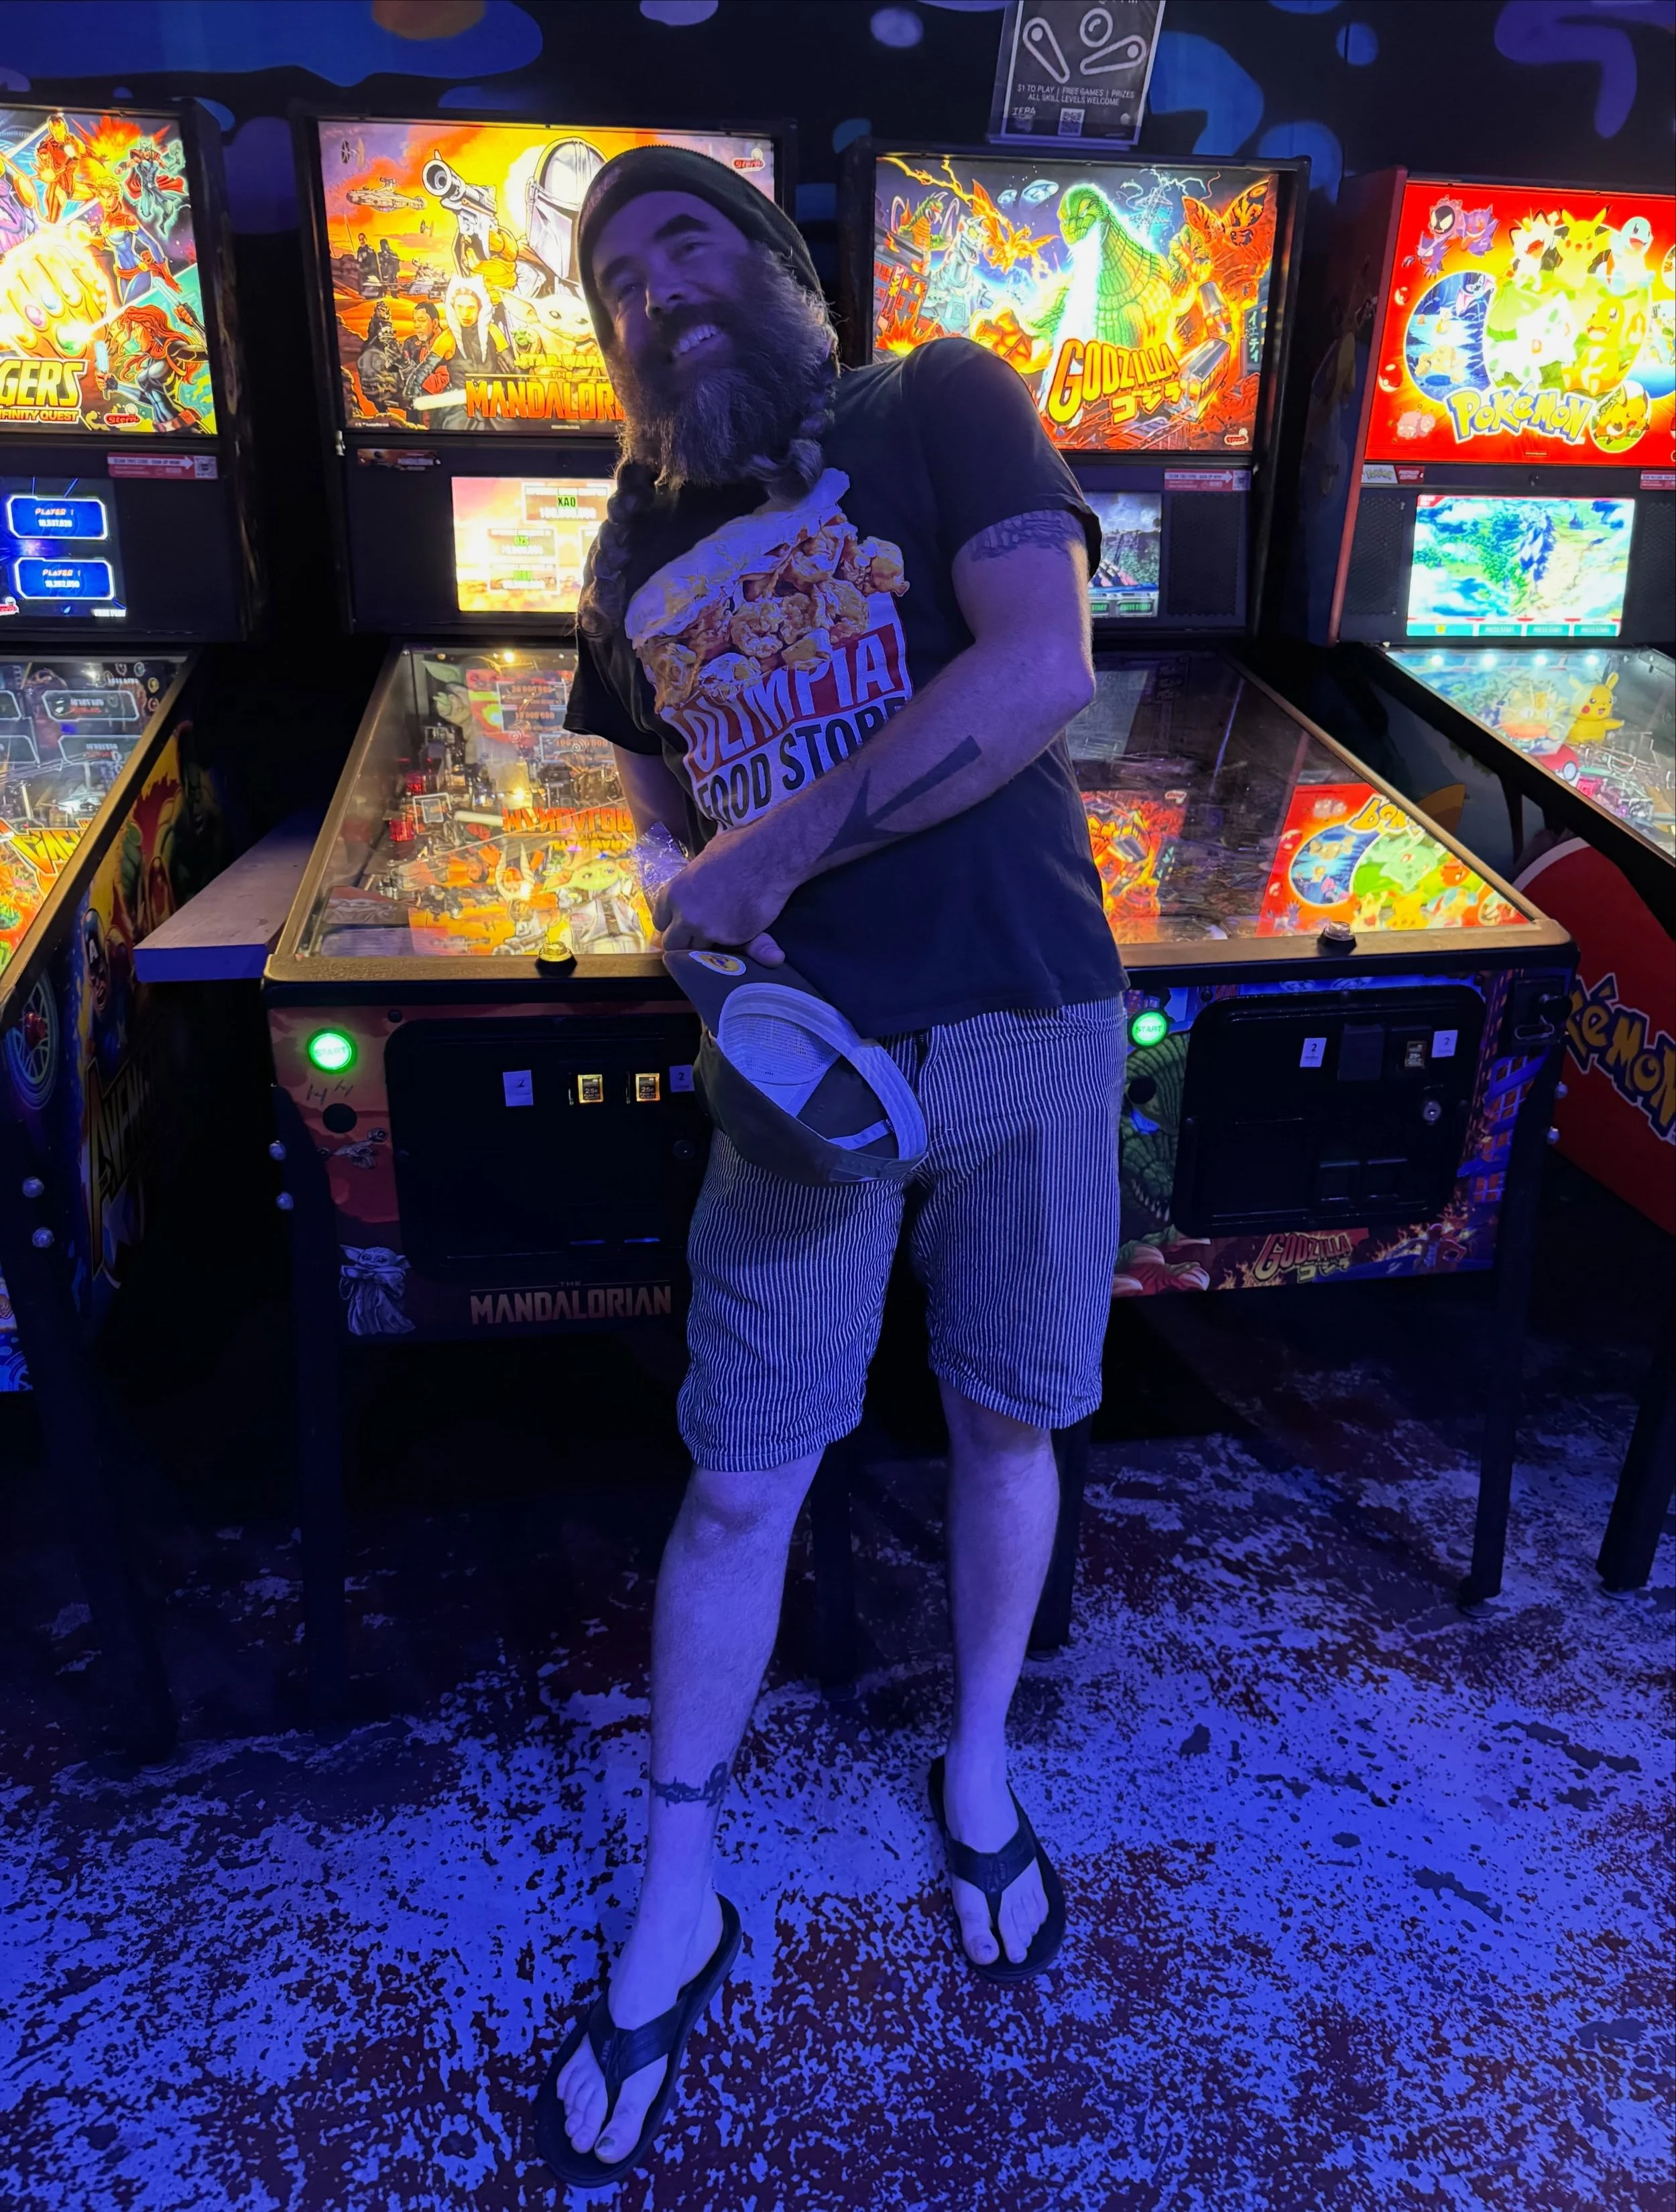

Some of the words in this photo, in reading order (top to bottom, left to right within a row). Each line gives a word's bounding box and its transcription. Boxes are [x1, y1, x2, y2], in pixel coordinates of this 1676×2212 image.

[1017, 83, 1025, 92] $1
[1027, 84, 1037, 93] TO
[1038, 84, 1055, 93] PLAY
[1062, 86, 1079, 95] FREE
[1079, 88, 1103, 97] GAMES
[1111, 90, 1136, 99] PRIZES
[1041, 94, 1060, 102] SKILL
[1061, 95, 1085, 103] LEVELS
[1087, 97, 1120, 106] WELCOME
[514, 353, 561, 369] STAR
[561, 354, 606, 371] WAR
[550, 371, 573, 379] THE
[1047, 338, 1181, 423] GODZILLA
[1111, 379, 1182, 424] ゴジラ
[0, 409, 40, 421] FINITY
[40, 410, 78, 422] QUEST
[683, 633, 896, 773] OLYMPIA
[697, 753, 772, 831] FOOD
[314, 1046, 347, 1057] START
[1311, 1043, 1317, 1052] 2
[678, 1072, 685, 1081] 2
[1254, 1232, 1352, 1282] GODZILLA
[470, 1285, 672, 1325] MANDALORIAN
